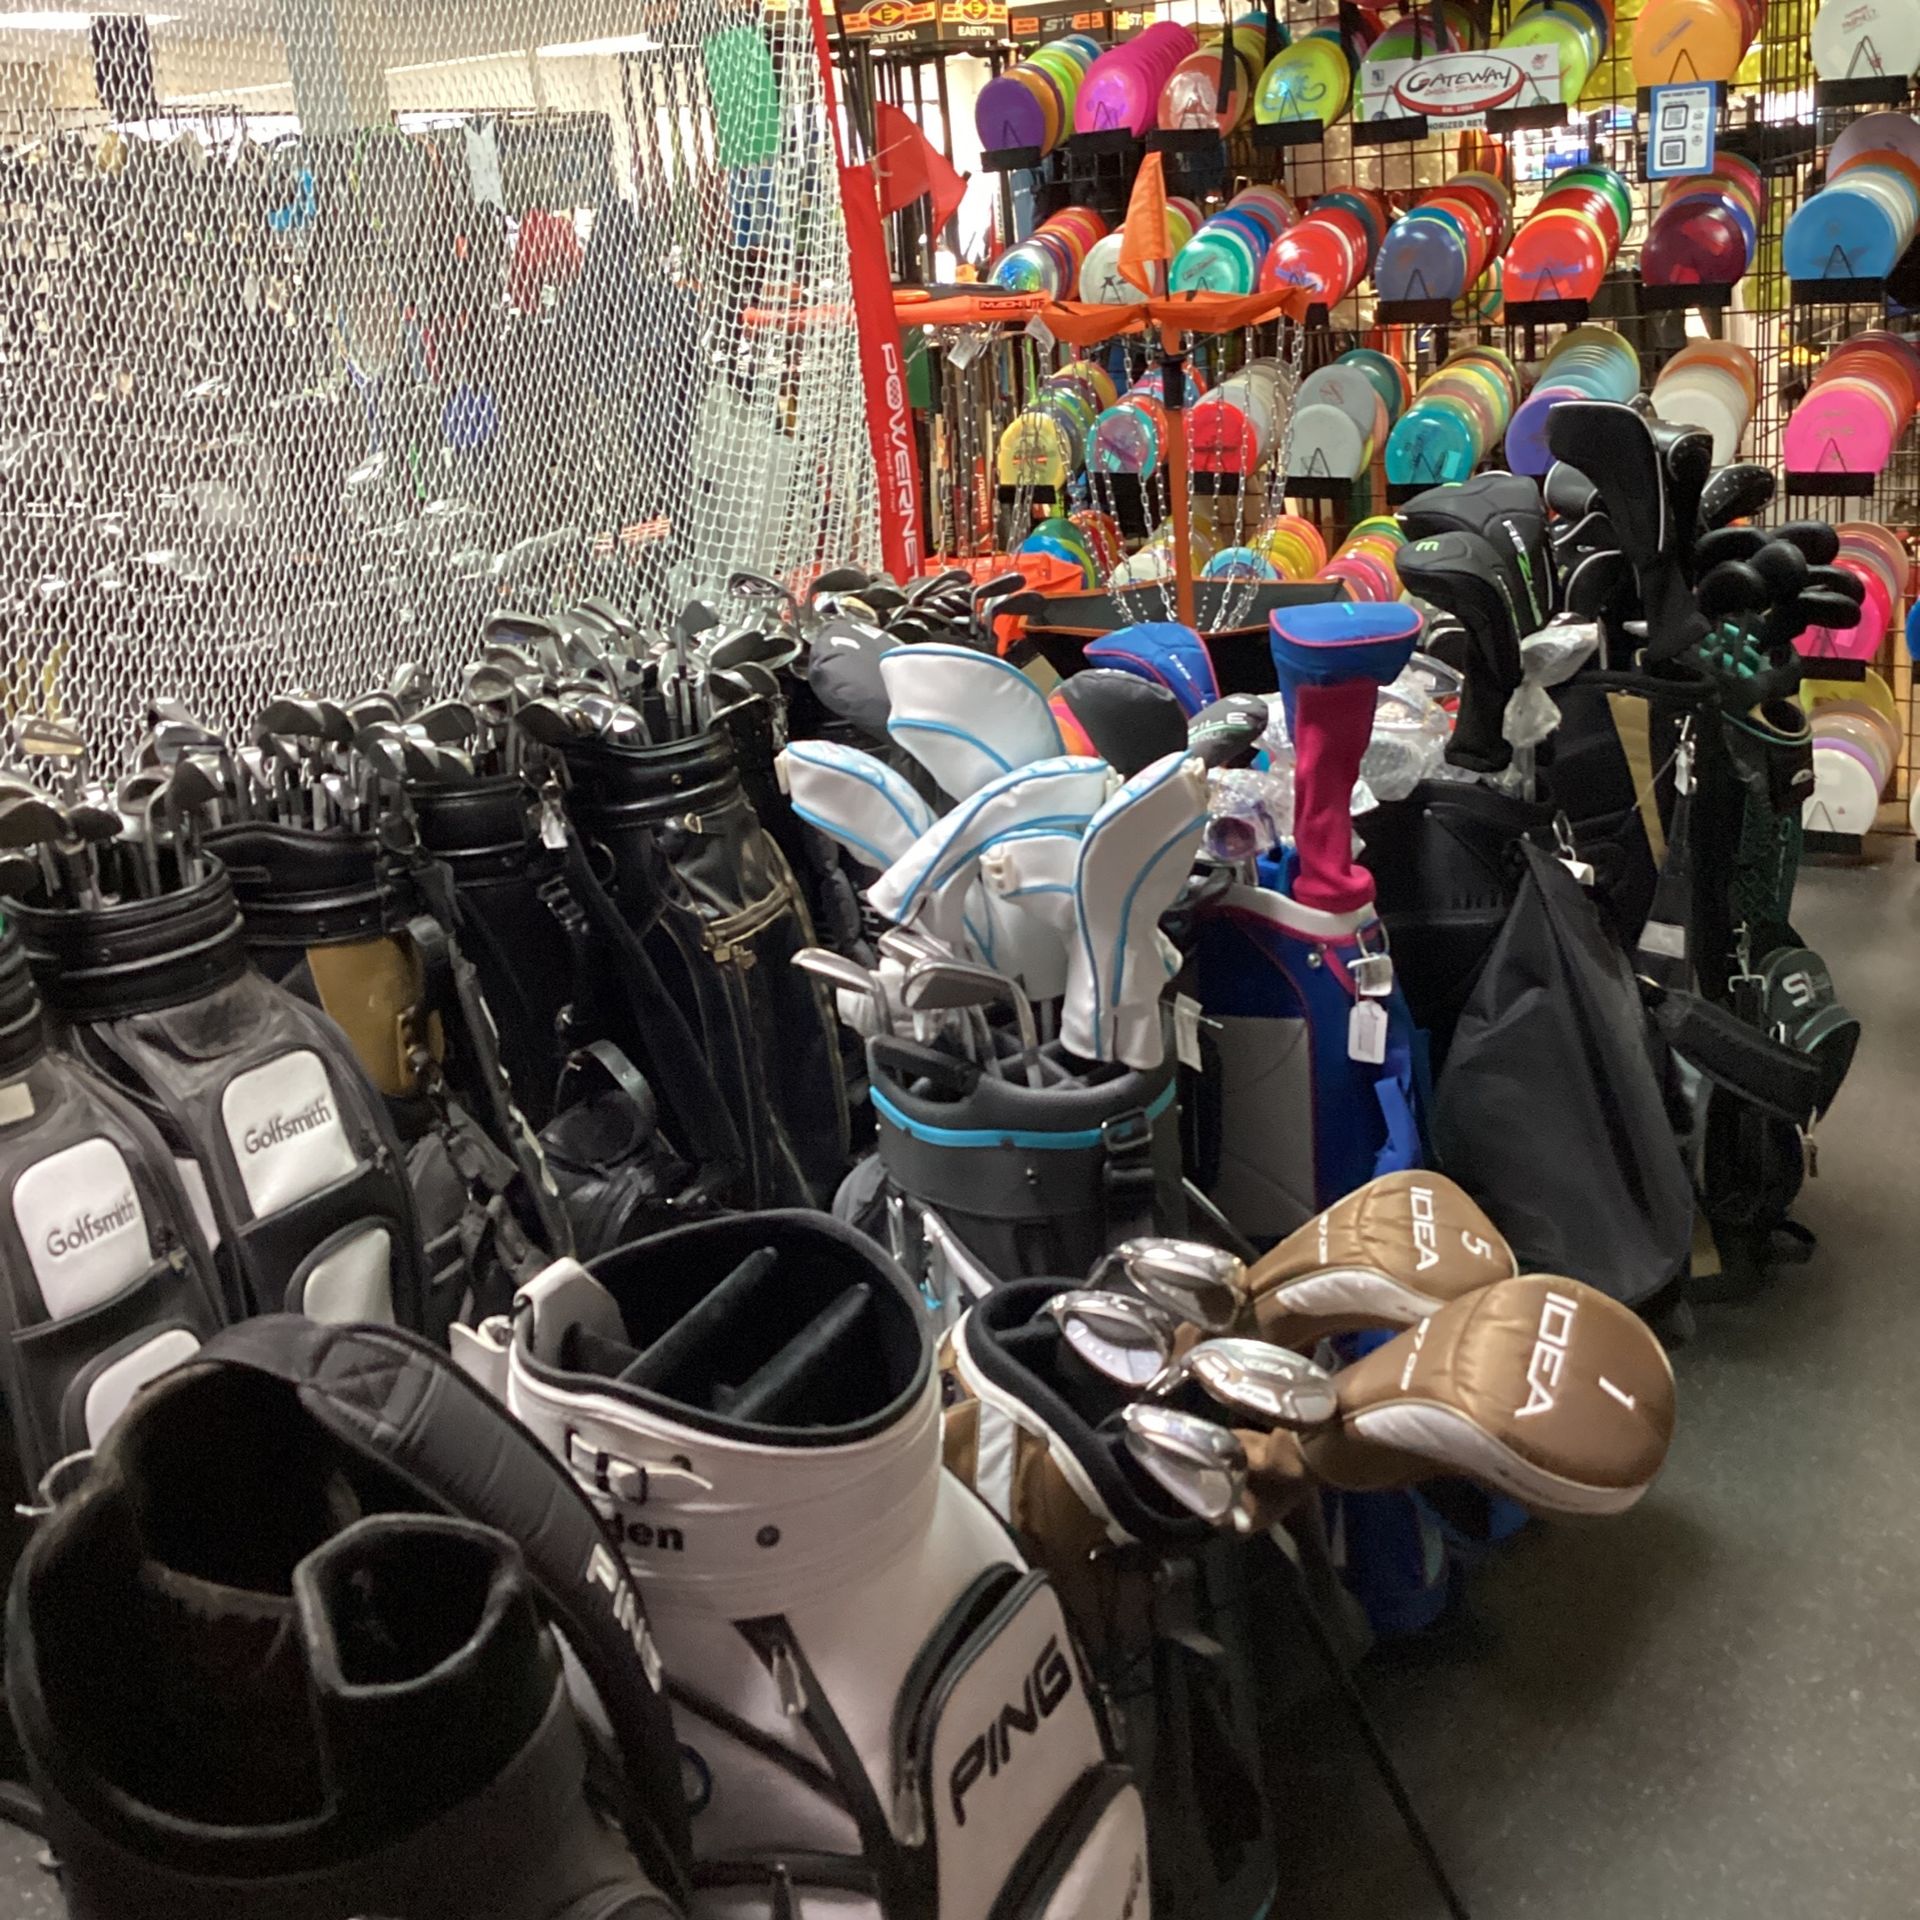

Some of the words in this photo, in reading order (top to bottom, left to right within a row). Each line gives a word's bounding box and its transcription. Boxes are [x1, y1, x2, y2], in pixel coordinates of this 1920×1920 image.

[871, 29, 917, 44] ASTON
[958, 25, 995, 37] EASTON
[1406, 66, 1512, 93] GATEWAY
[244, 1094, 332, 1154] Golfsmith
[46, 1193, 138, 1257] Golfsmith
[1410, 1186, 1440, 1271] IDEA
[1461, 1230, 1492, 1260] 5
[1514, 1291, 1578, 1418] IDEA
[1598, 1376, 1635, 1411] 1
[603, 1513, 684, 1551] den
[949, 1633, 1072, 1837] PING
